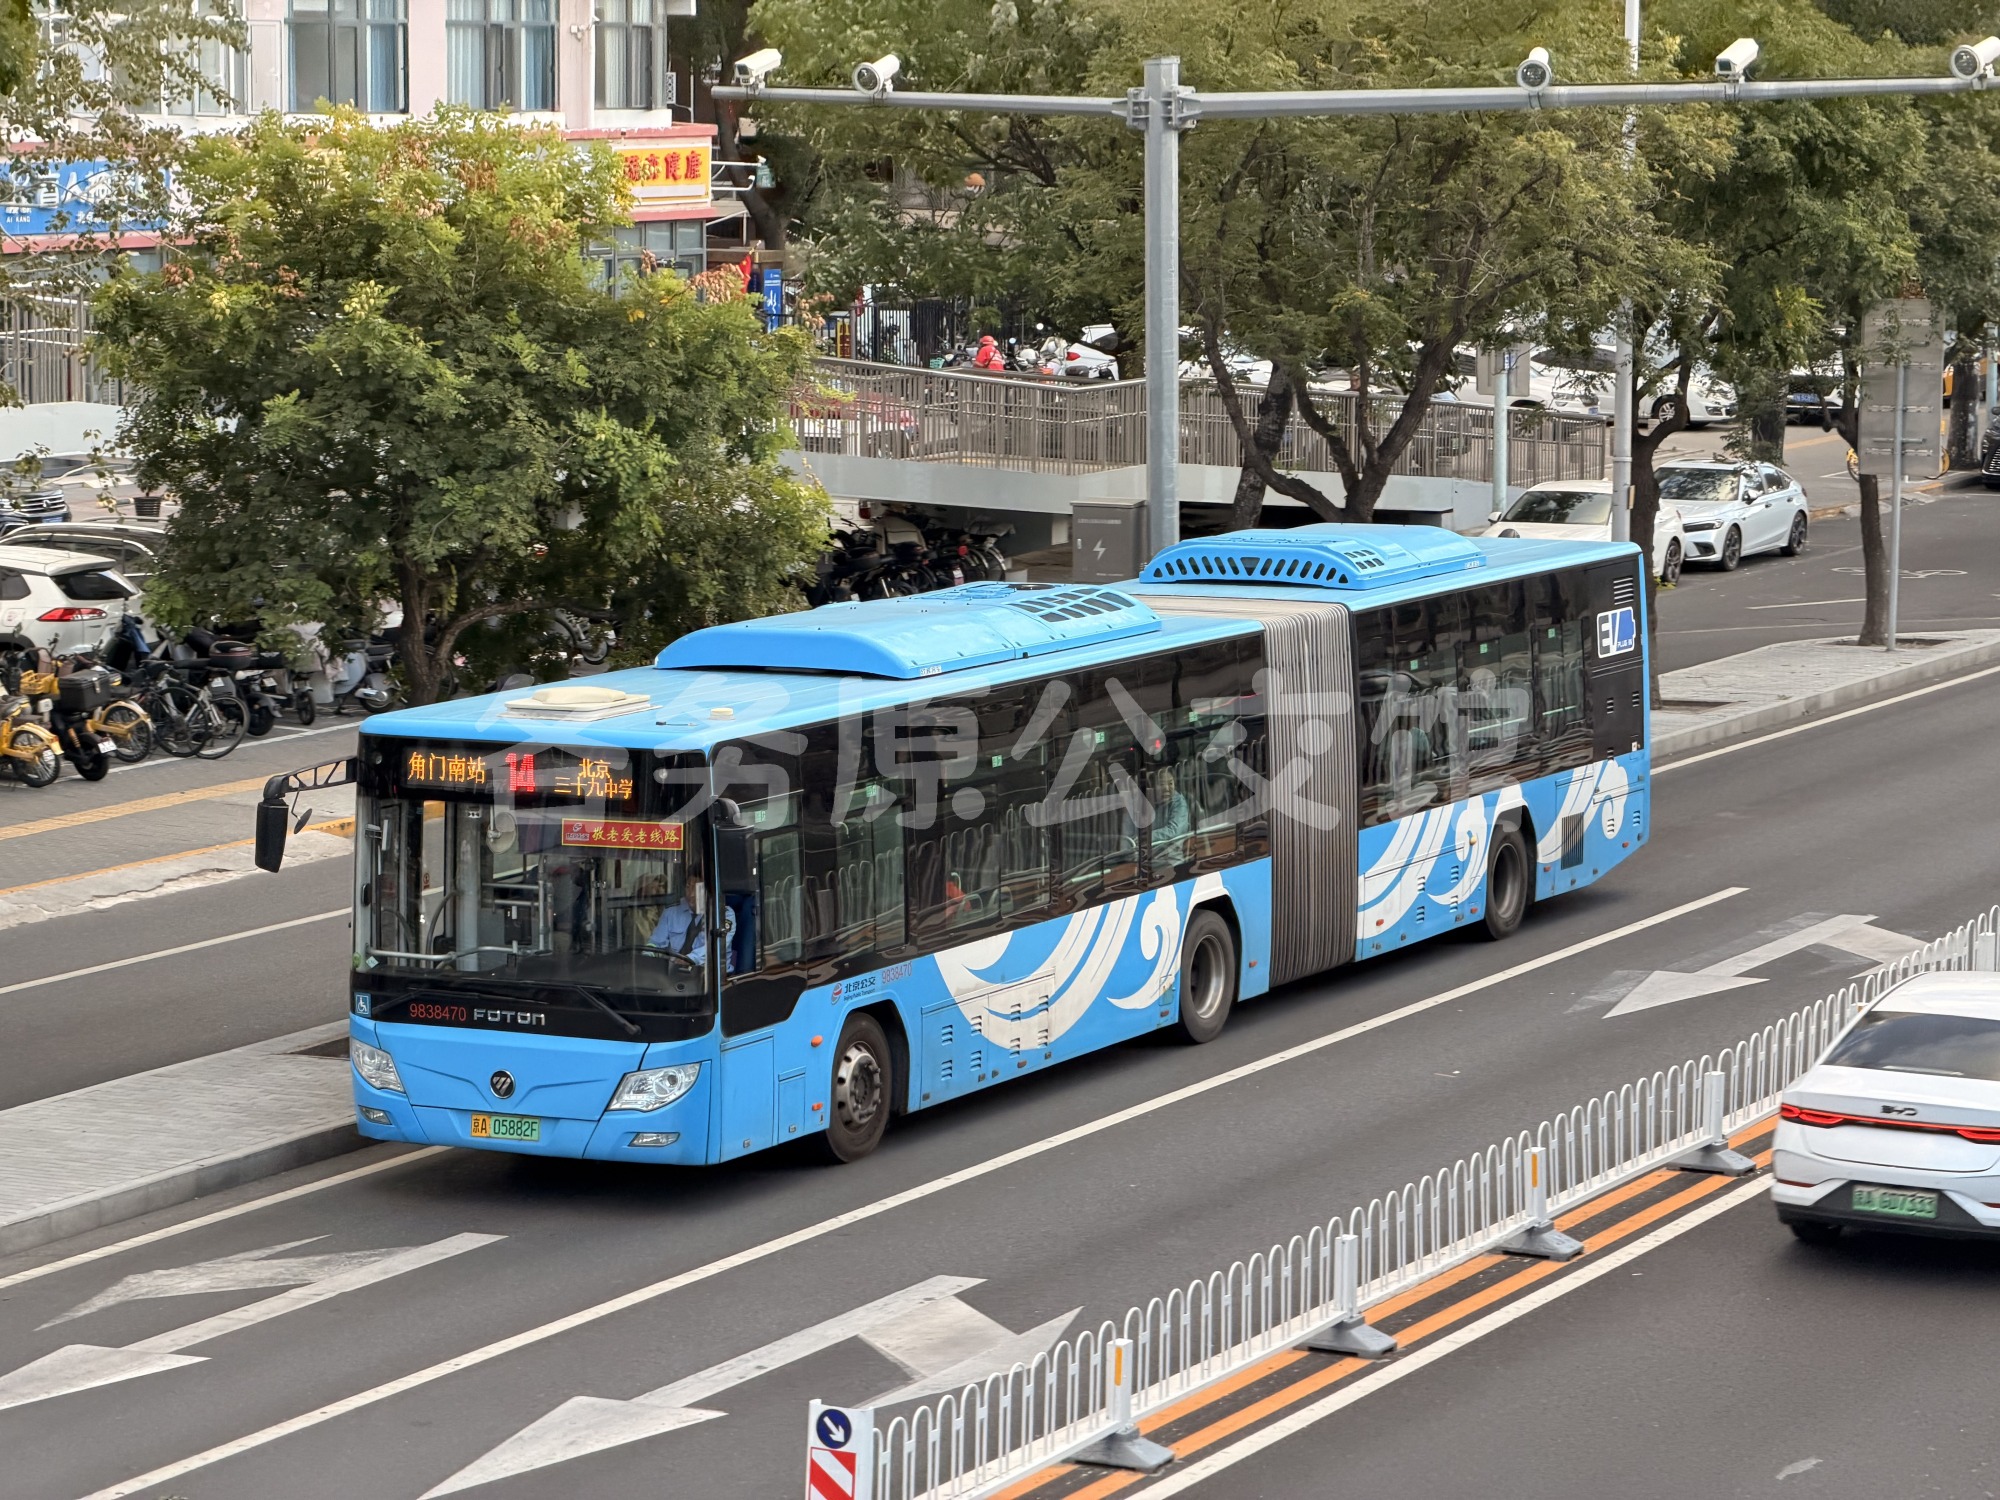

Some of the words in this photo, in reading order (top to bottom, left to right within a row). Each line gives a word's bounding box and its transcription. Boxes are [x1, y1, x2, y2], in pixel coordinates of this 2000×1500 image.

[408, 751, 486, 784] 角门南站
[505, 752, 536, 792] 14
[578, 758, 611, 779] 北京
[554, 776, 633, 799] 三十九中学
[592, 826, 680, 844] 敬老爱老线路
[881, 962, 912, 984] 9838470
[844, 976, 876, 994] 北京公交
[409, 1002, 467, 1022] 9838470
[473, 1007, 546, 1026] FOTON
